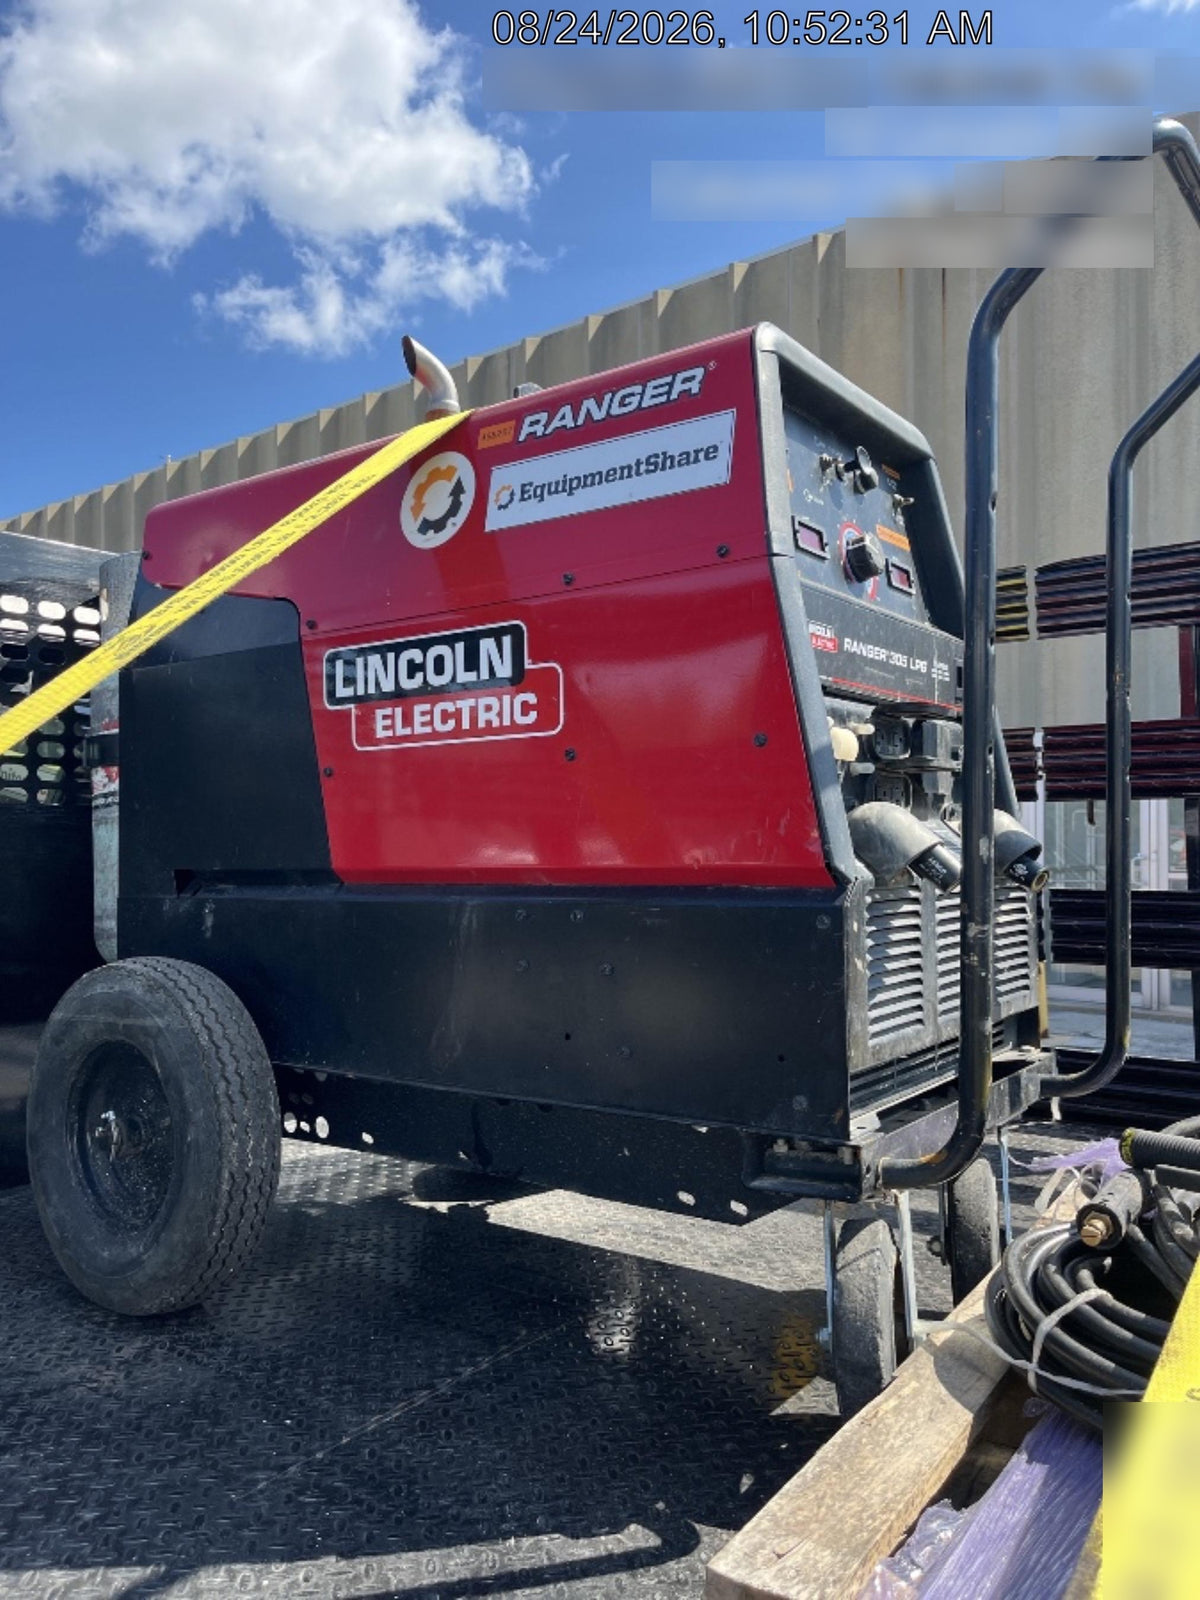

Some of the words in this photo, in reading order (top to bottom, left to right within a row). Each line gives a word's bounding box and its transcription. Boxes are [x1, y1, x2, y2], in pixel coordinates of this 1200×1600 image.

[517, 366, 705, 443] RANGER
[518, 442, 719, 503] EquipmentShare
[335, 634, 513, 698] LINCOLN
[843, 637, 887, 662] RANGER
[374, 692, 538, 738] ELECTRIC
